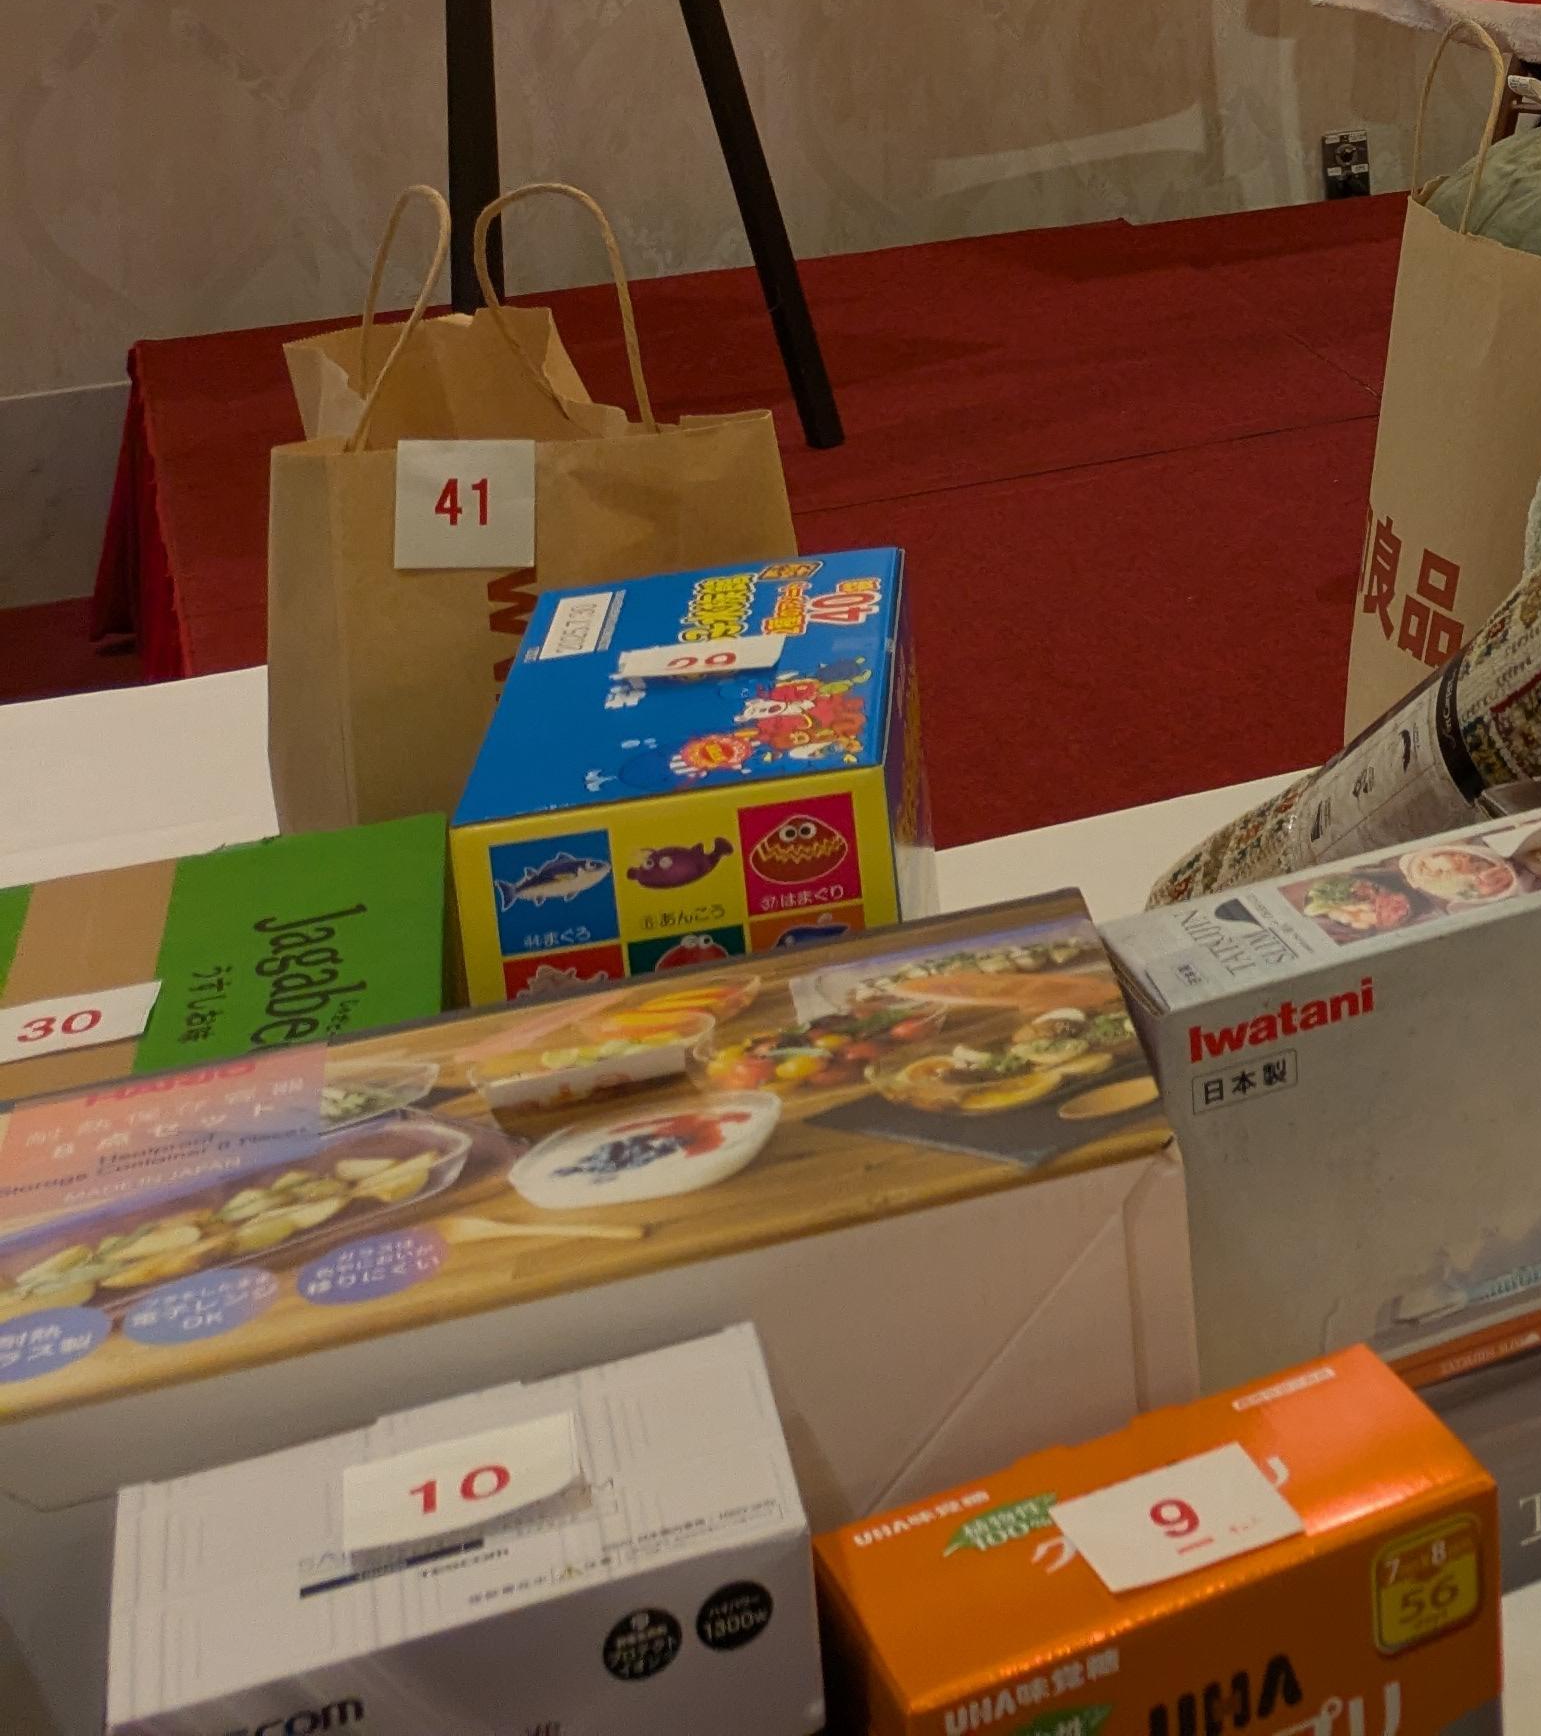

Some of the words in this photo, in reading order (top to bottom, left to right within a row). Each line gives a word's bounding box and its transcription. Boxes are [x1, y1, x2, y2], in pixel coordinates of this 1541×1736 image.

[434, 478, 490, 527] 41
[780, 885, 844, 909] はまぐり
[17, 1009, 102, 1043] 30
[1189, 976, 1375, 1064] Iwatani
[1203, 1058, 1287, 1105] 日本製
[410, 1464, 511, 1516] 10
[1150, 1497, 1201, 1540] 9
[1399, 1578, 1459, 1625] 56
